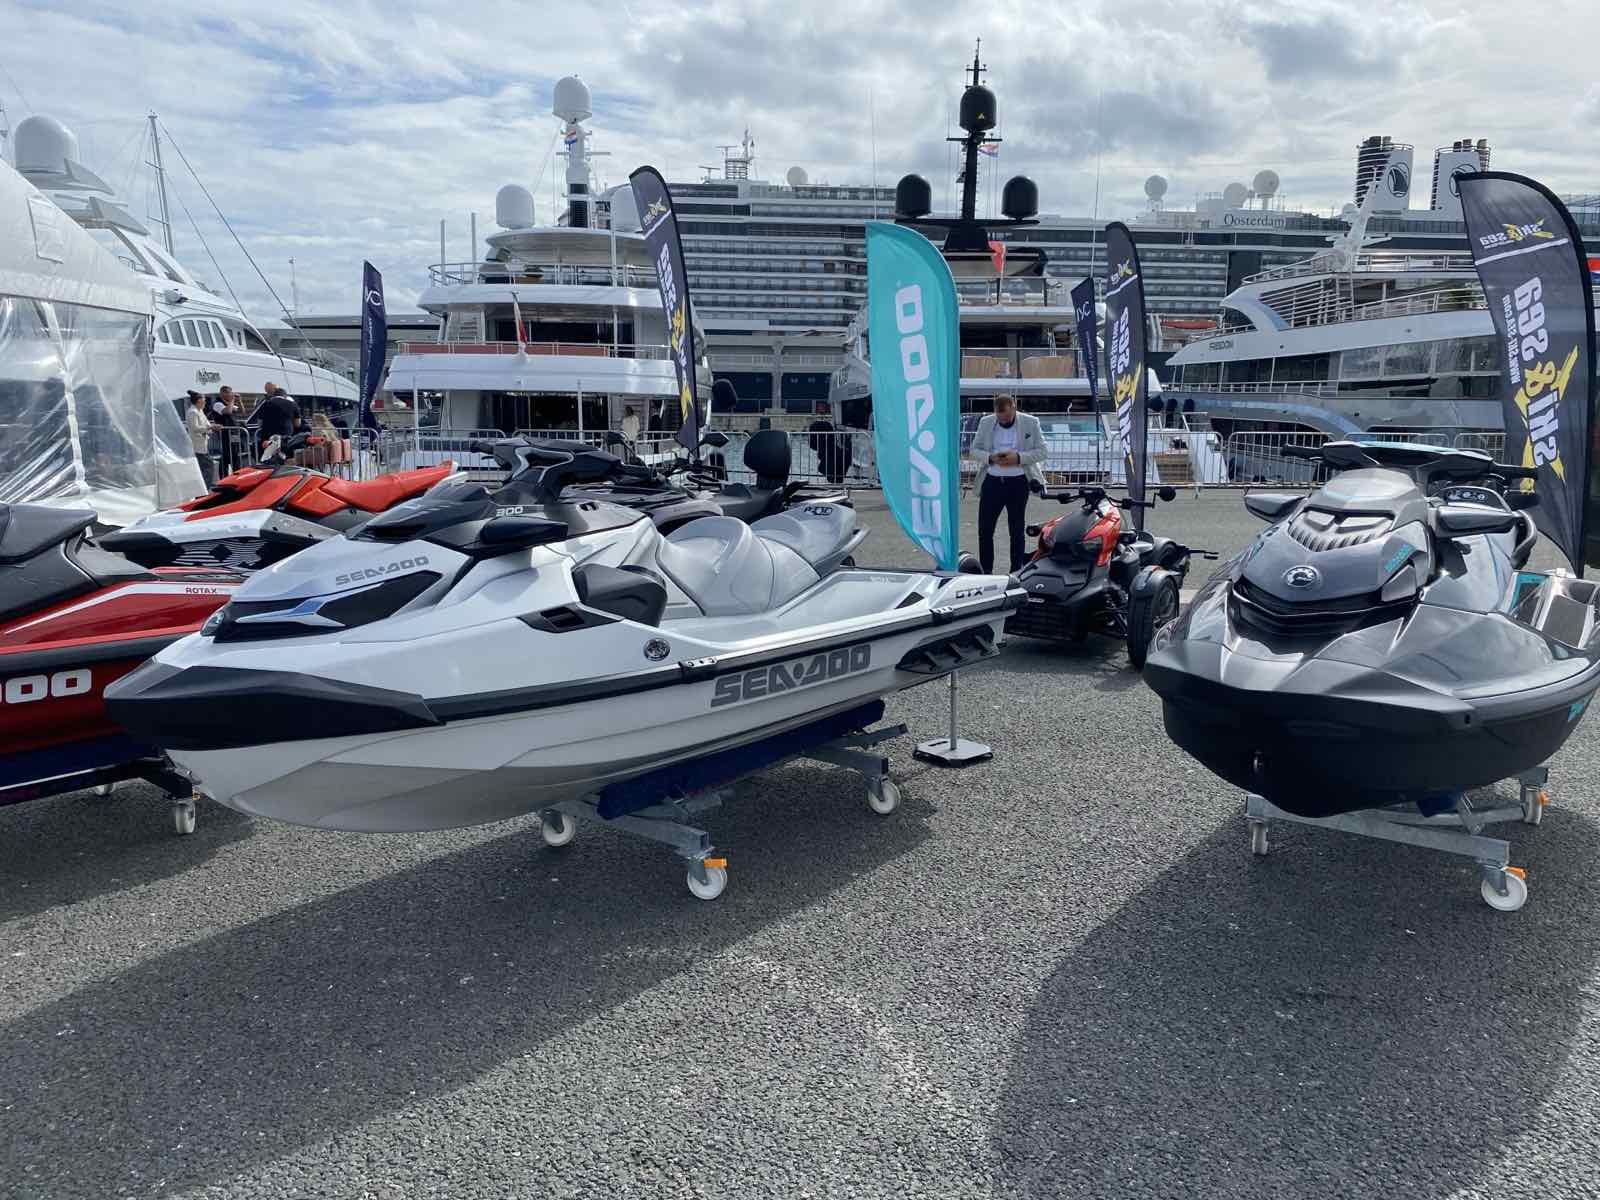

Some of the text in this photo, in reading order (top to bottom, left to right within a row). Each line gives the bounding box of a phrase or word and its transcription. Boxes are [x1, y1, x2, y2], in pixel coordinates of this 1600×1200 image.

[1224, 213, 1286, 227] Oosterdam
[496, 506, 524, 518] 300
[955, 587, 983, 599] GTX
[0, 668, 92, 704] OO
